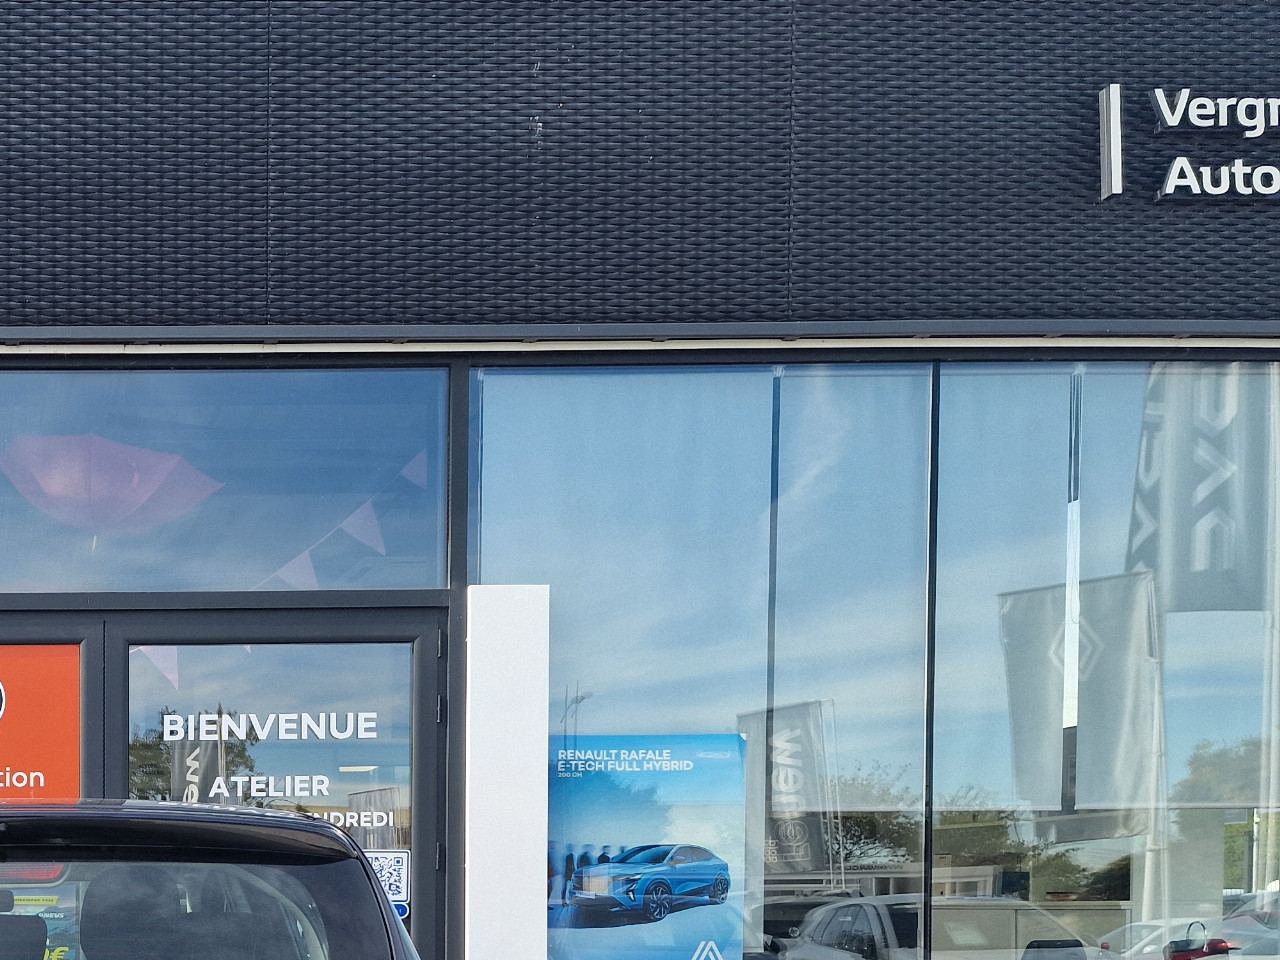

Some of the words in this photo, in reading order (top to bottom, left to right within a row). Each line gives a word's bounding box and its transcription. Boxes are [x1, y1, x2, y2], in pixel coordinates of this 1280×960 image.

[1165, 156, 1280, 196] Auto
[162, 711, 378, 742] BIENVENUE
[557, 760, 605, 772] E-TECH
[607, 760, 641, 771] FULL
[643, 760, 694, 772] HYBRID
[558, 749, 618, 761] RENAULT
[620, 749, 671, 761] RAFALE
[208, 774, 330, 798] ATELIER
